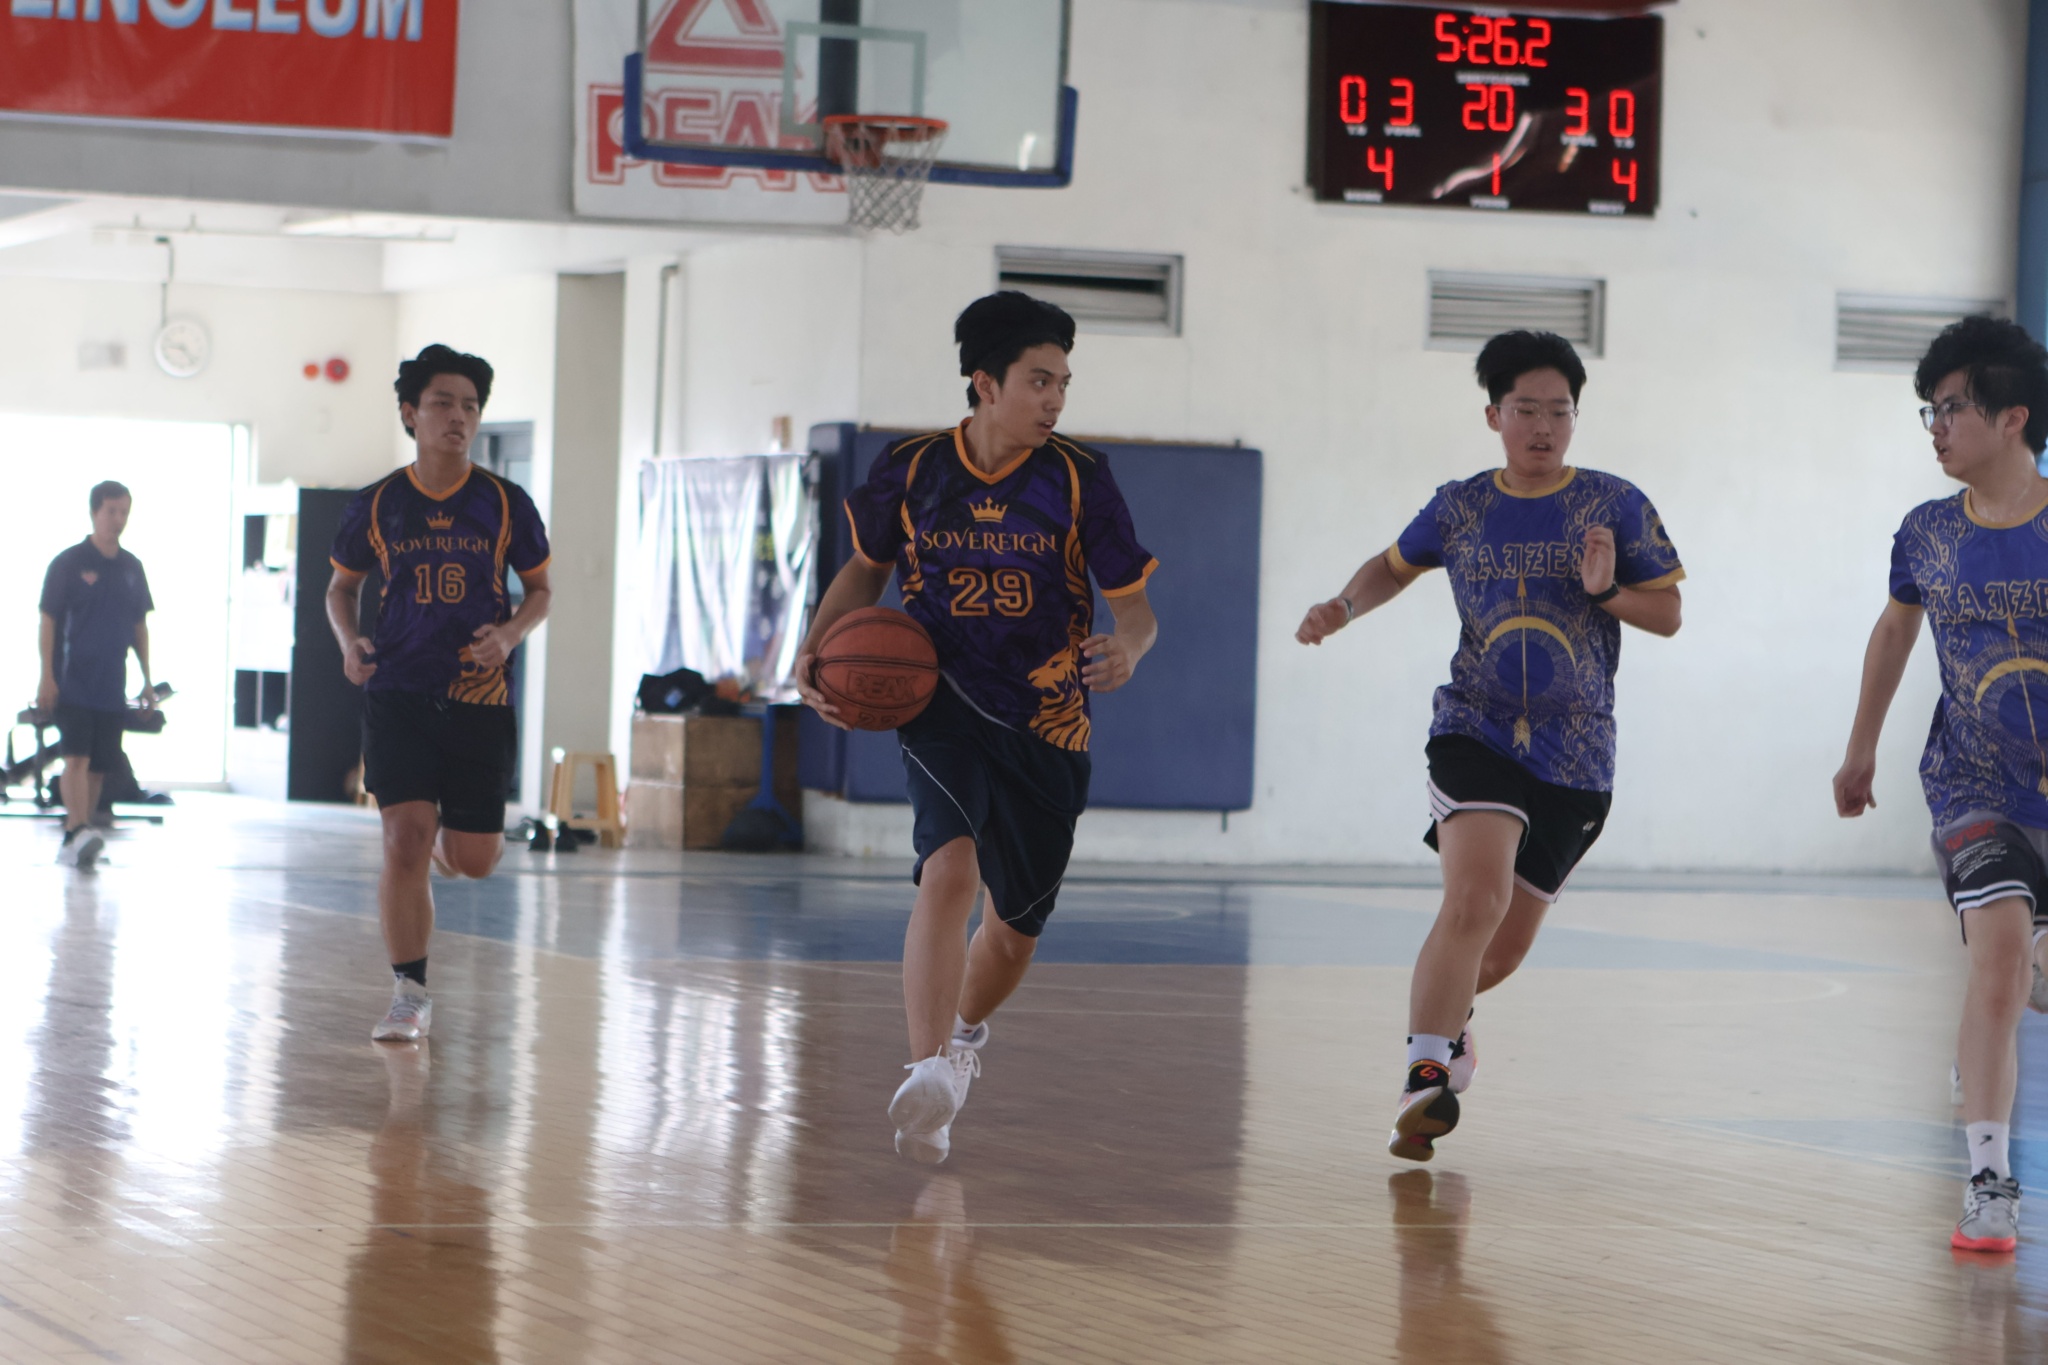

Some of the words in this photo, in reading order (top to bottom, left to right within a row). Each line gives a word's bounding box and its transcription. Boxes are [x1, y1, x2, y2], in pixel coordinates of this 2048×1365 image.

[11, 0, 424, 41] OLEUM
[1435, 13, 1551, 68] 5:26.2
[1340, 75, 1367, 124] 0
[1389, 79, 1414, 126] 3
[1462, 84, 1515, 131] 20
[1565, 88, 1589, 136] 3
[1608, 90, 1635, 138] 0
[1367, 146, 1394, 191] 4
[1492, 152, 1501, 196] 1
[1612, 158, 1638, 203] 4
[391, 534, 490, 557] SOVEREIGN
[921, 527, 1058, 555] SOVEREIGN
[415, 563, 466, 604] 16
[948, 568, 1034, 617] 29
[847, 670, 919, 702] PEAK
